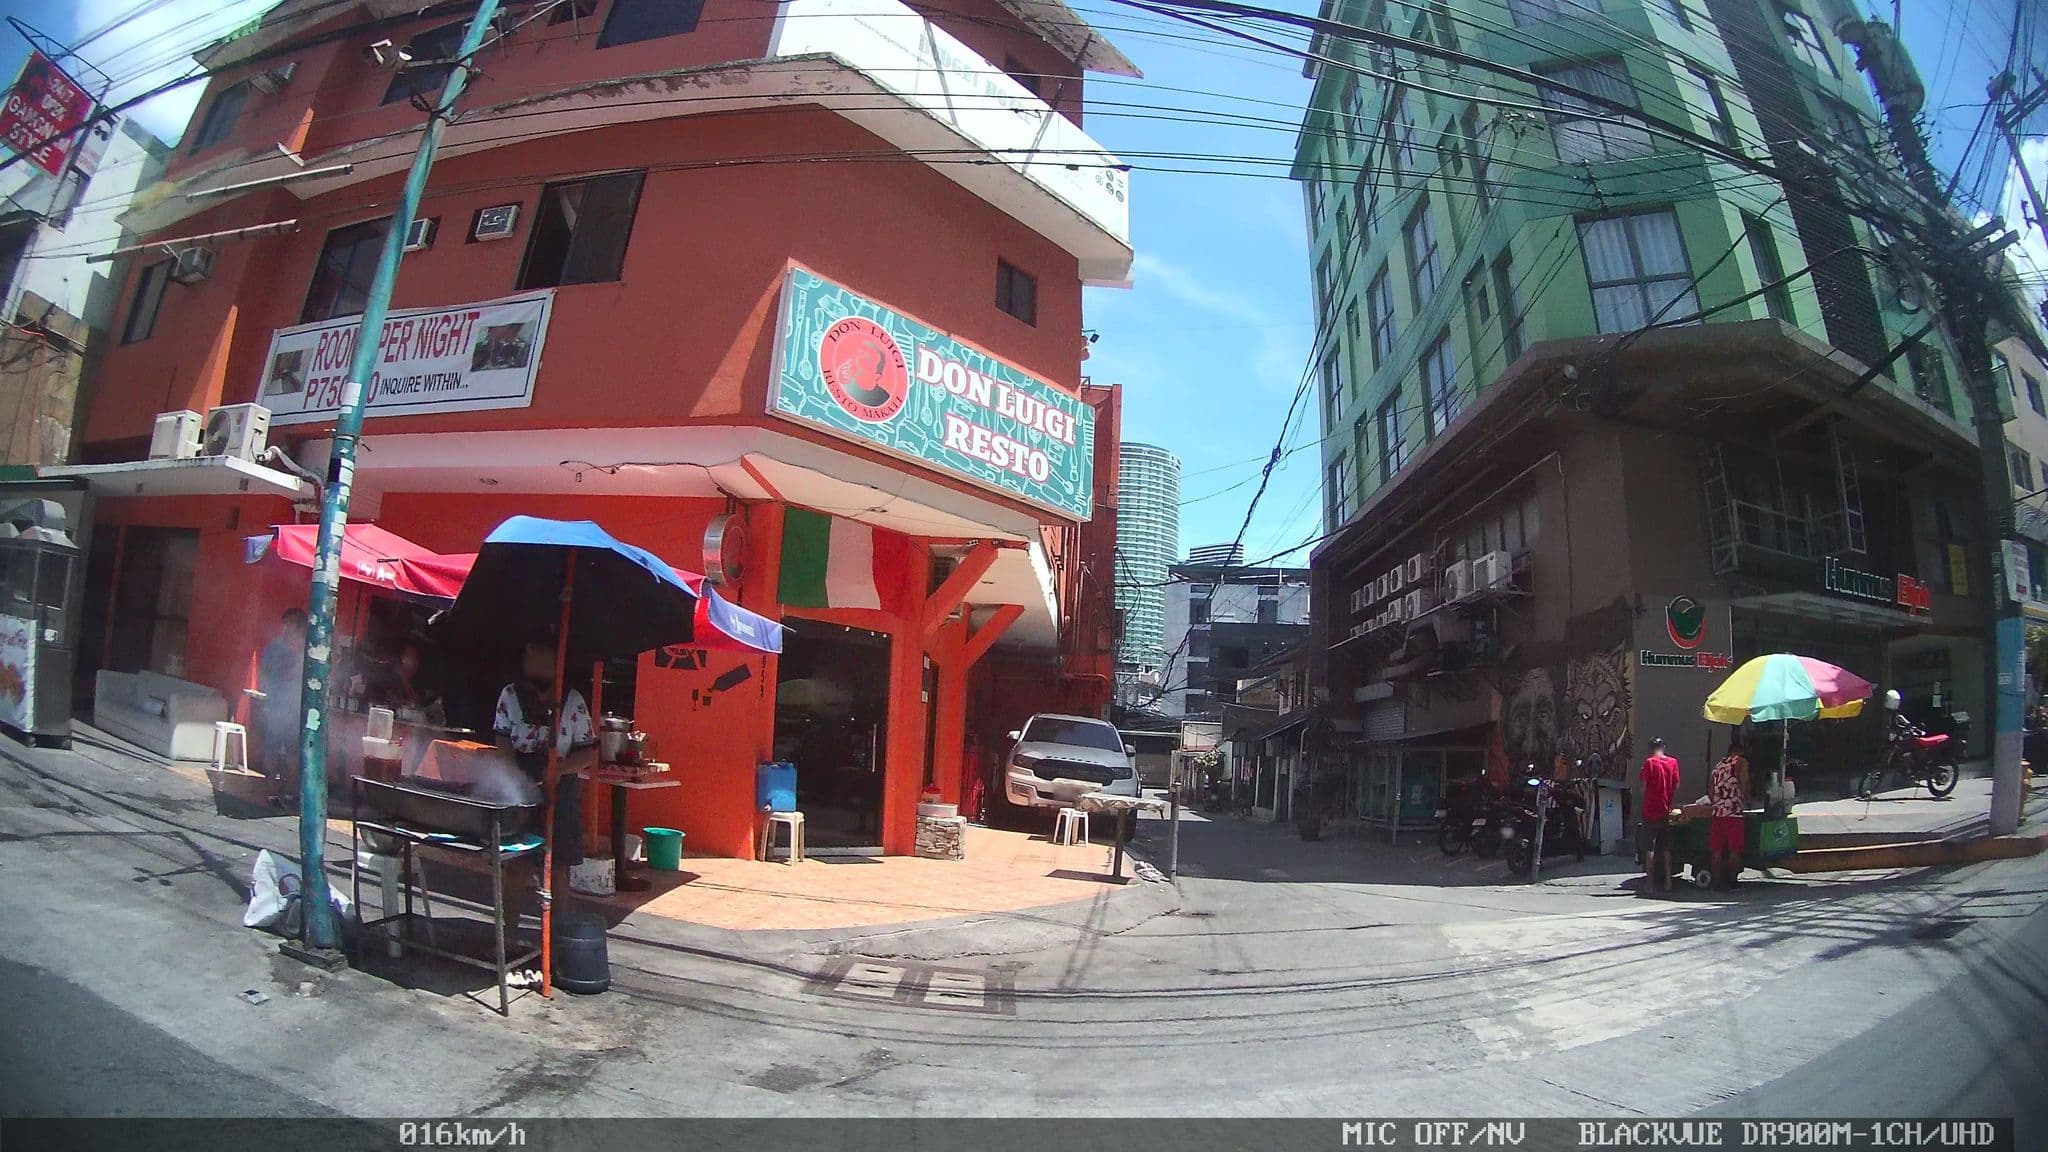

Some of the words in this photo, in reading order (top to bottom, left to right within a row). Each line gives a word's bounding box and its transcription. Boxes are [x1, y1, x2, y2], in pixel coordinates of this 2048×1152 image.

[378, 319, 415, 364] PER
[412, 311, 480, 360] NIGHT
[828, 320, 861, 343] DON
[871, 326, 904, 369] LUIGI
[380, 374, 422, 396] INQUIRE
[423, 372, 469, 392] WITHIN...
[823, 370, 857, 412] RESTO
[863, 396, 903, 419] MAKATI
[917, 345, 994, 408] DON
[996, 380, 1077, 446] LUIGI
[944, 413, 1049, 482] RESTO
[1640, 650, 1695, 668] Hummus
